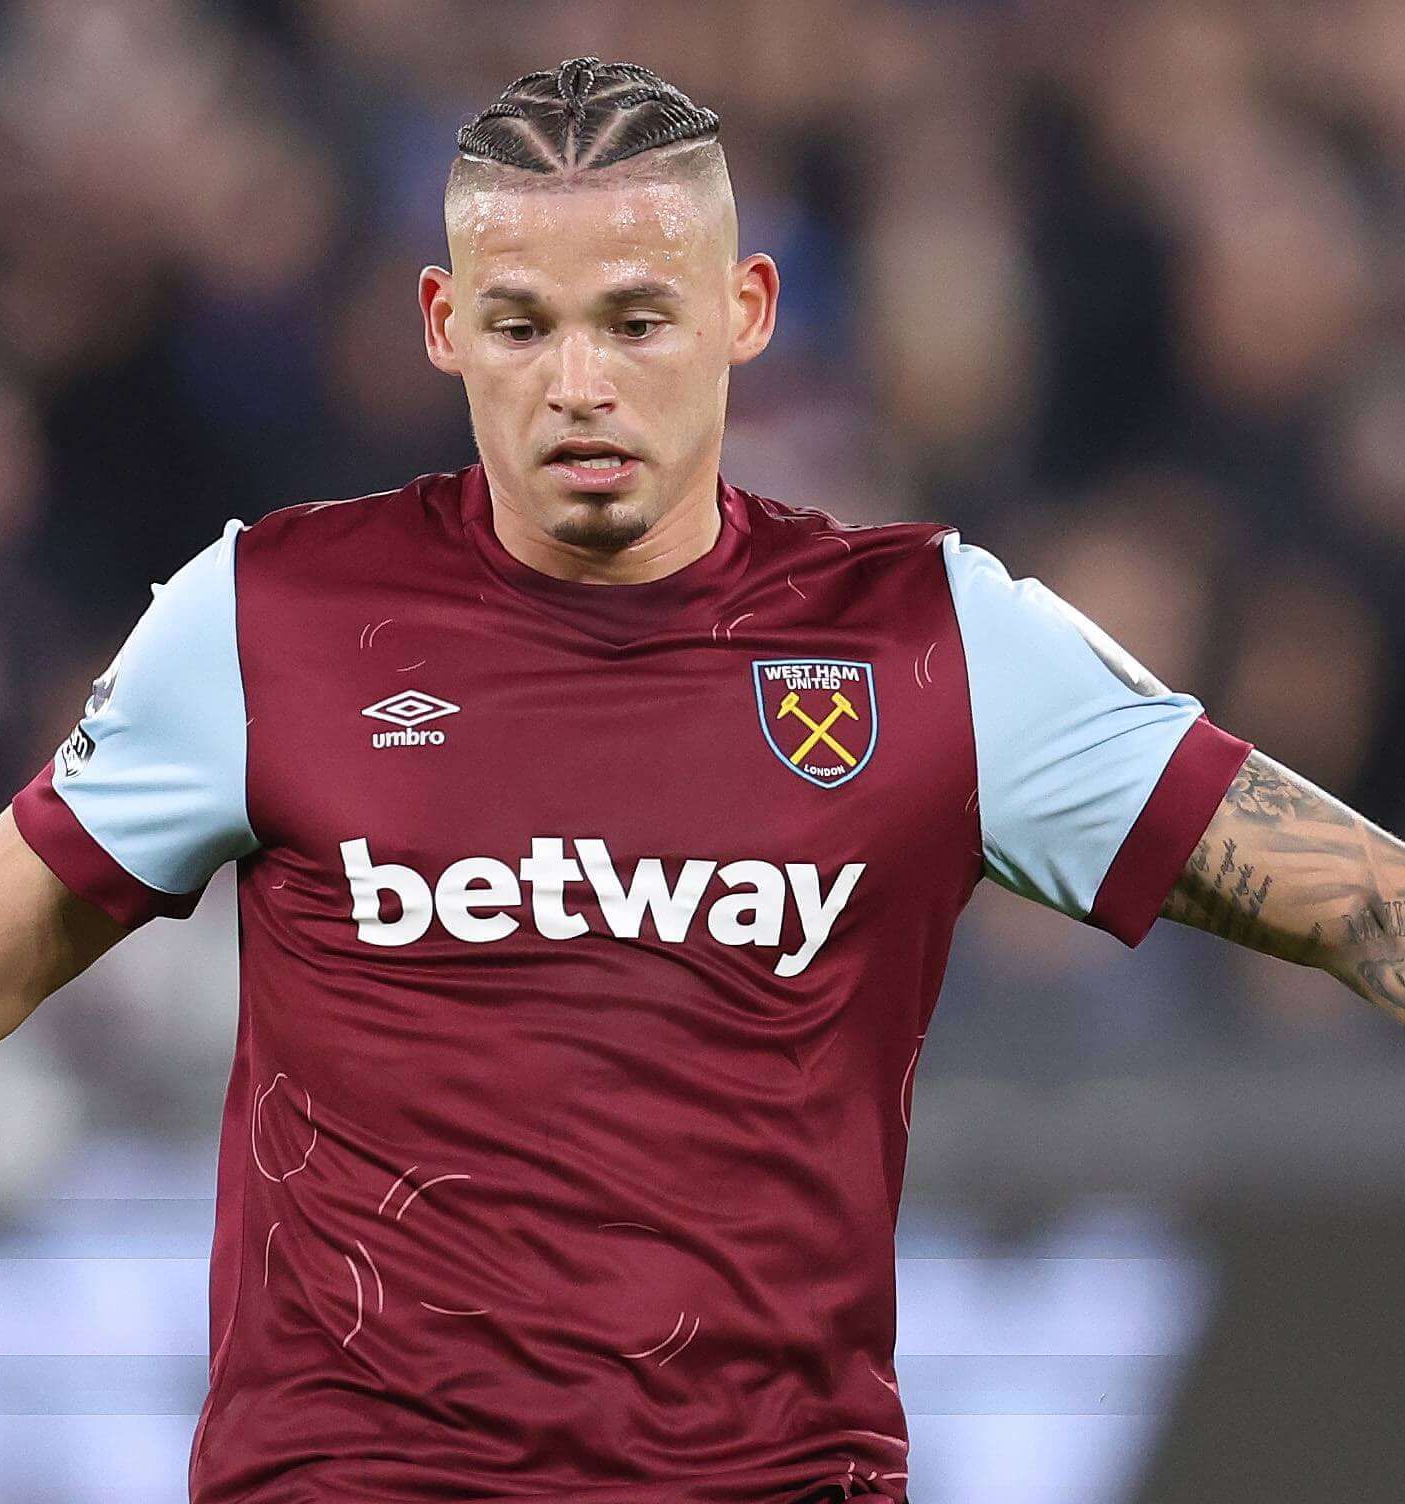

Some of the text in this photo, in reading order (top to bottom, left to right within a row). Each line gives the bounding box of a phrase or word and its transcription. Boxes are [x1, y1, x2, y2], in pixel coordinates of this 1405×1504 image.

[764, 664, 860, 682] WEST HAM
[786, 678, 841, 690] UNITED
[372, 727, 445, 749] umbro
[803, 763, 846, 777] LONDON
[339, 836, 867, 978] betway
